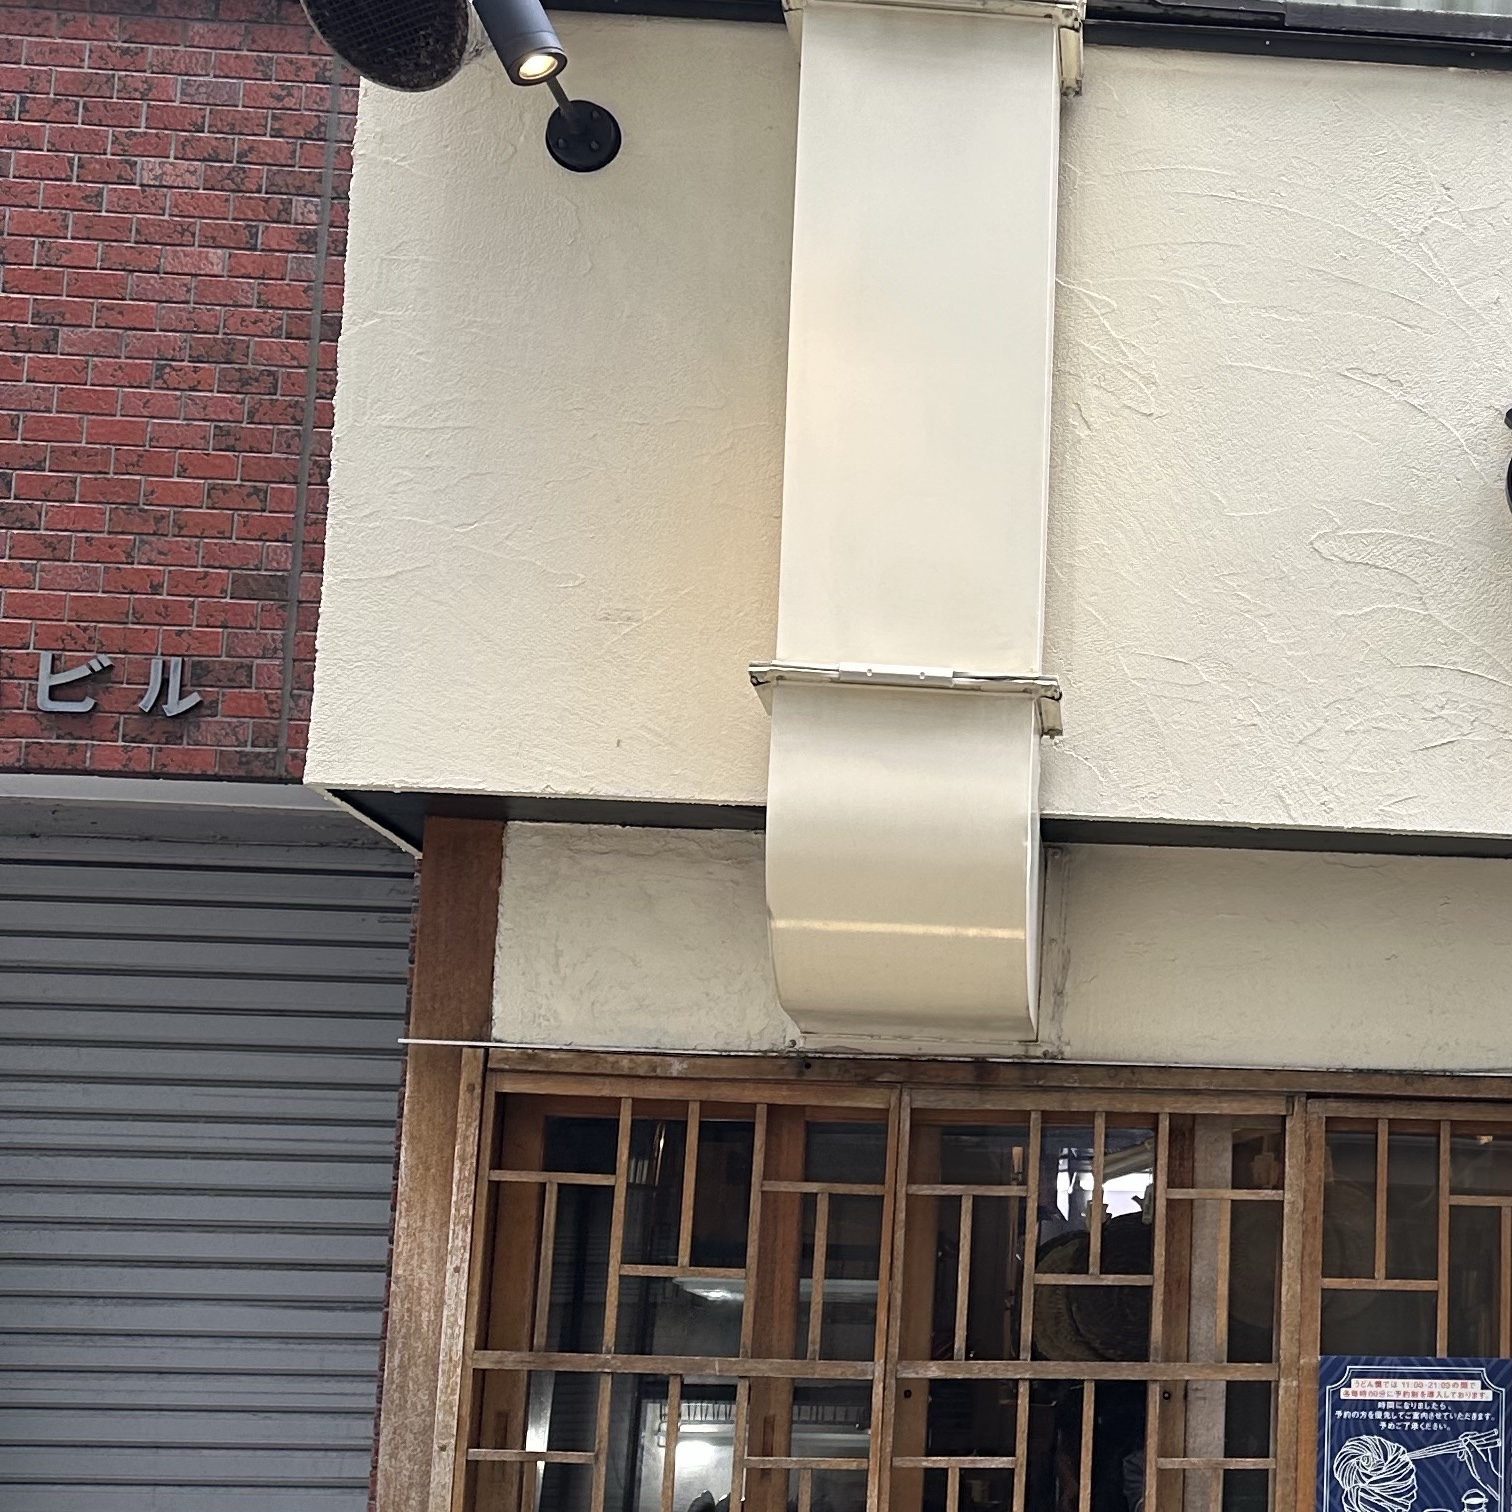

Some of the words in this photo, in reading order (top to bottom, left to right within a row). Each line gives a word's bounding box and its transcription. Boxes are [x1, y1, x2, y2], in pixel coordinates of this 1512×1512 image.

[37, 650, 203, 717] ビル
[1379, 1421, 1450, 1431] 予めご了承ください。
